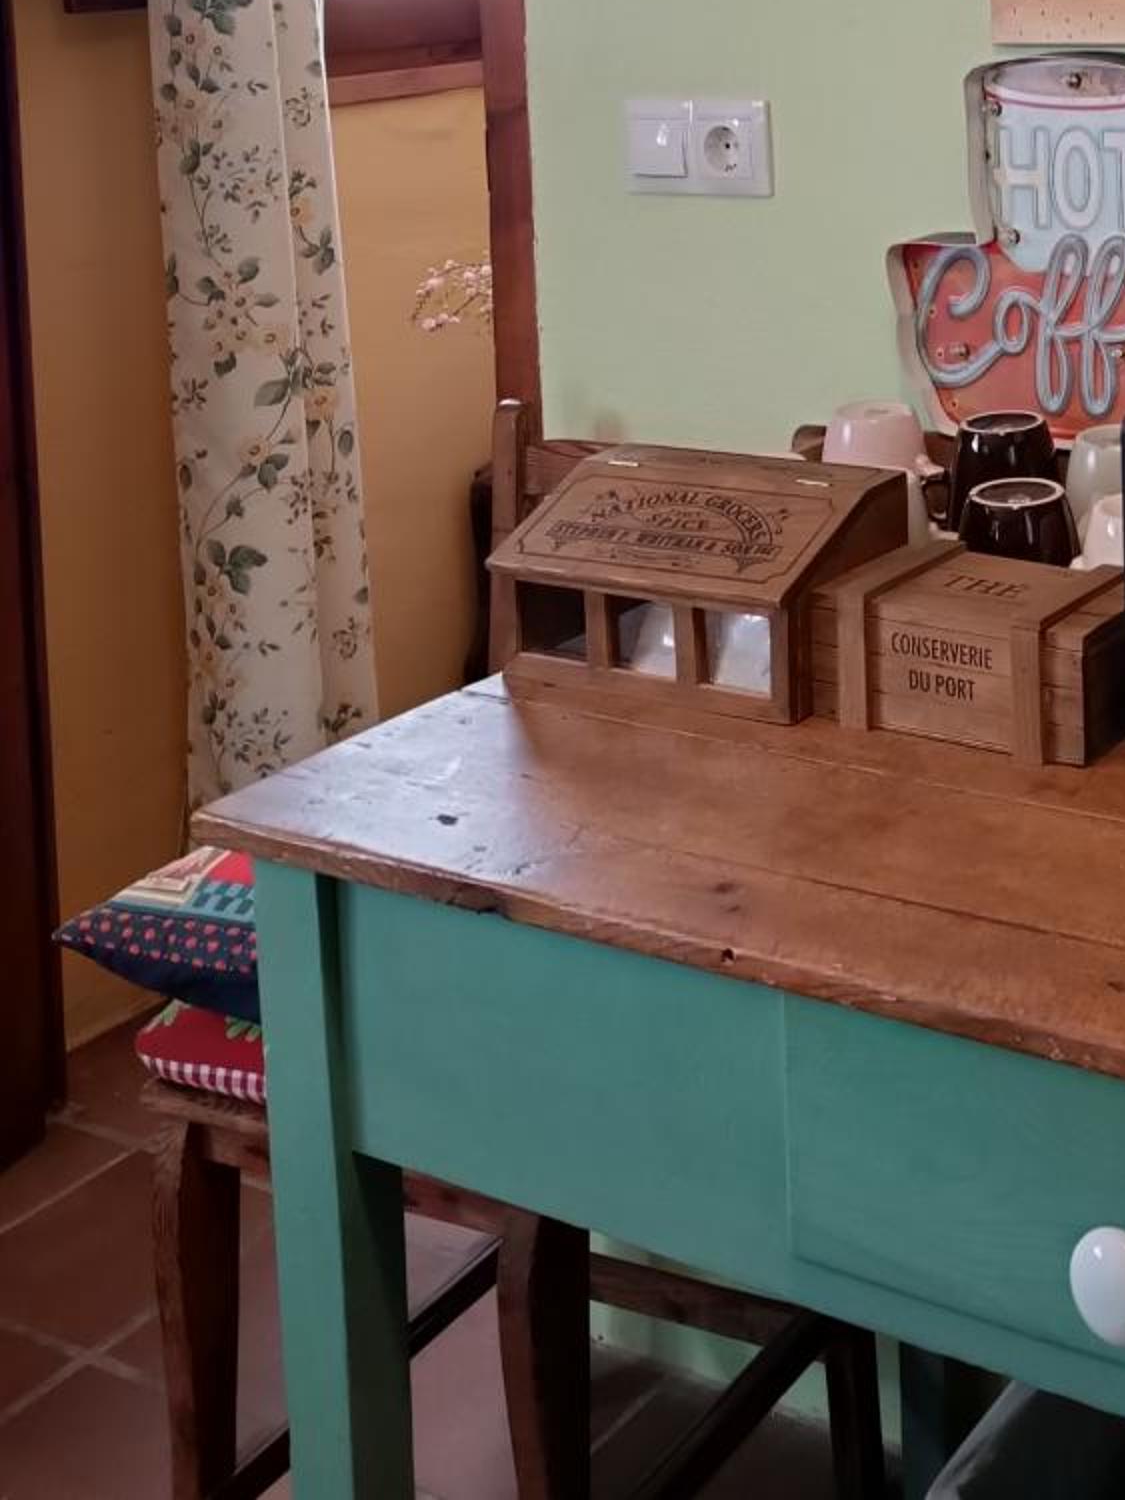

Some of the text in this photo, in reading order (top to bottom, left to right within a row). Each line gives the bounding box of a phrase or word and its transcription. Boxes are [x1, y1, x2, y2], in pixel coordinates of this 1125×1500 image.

[943, 573, 1031, 599] THE
[891, 631, 993, 670] CONSERVERIE
[908, 669, 977, 701] DU PORT
